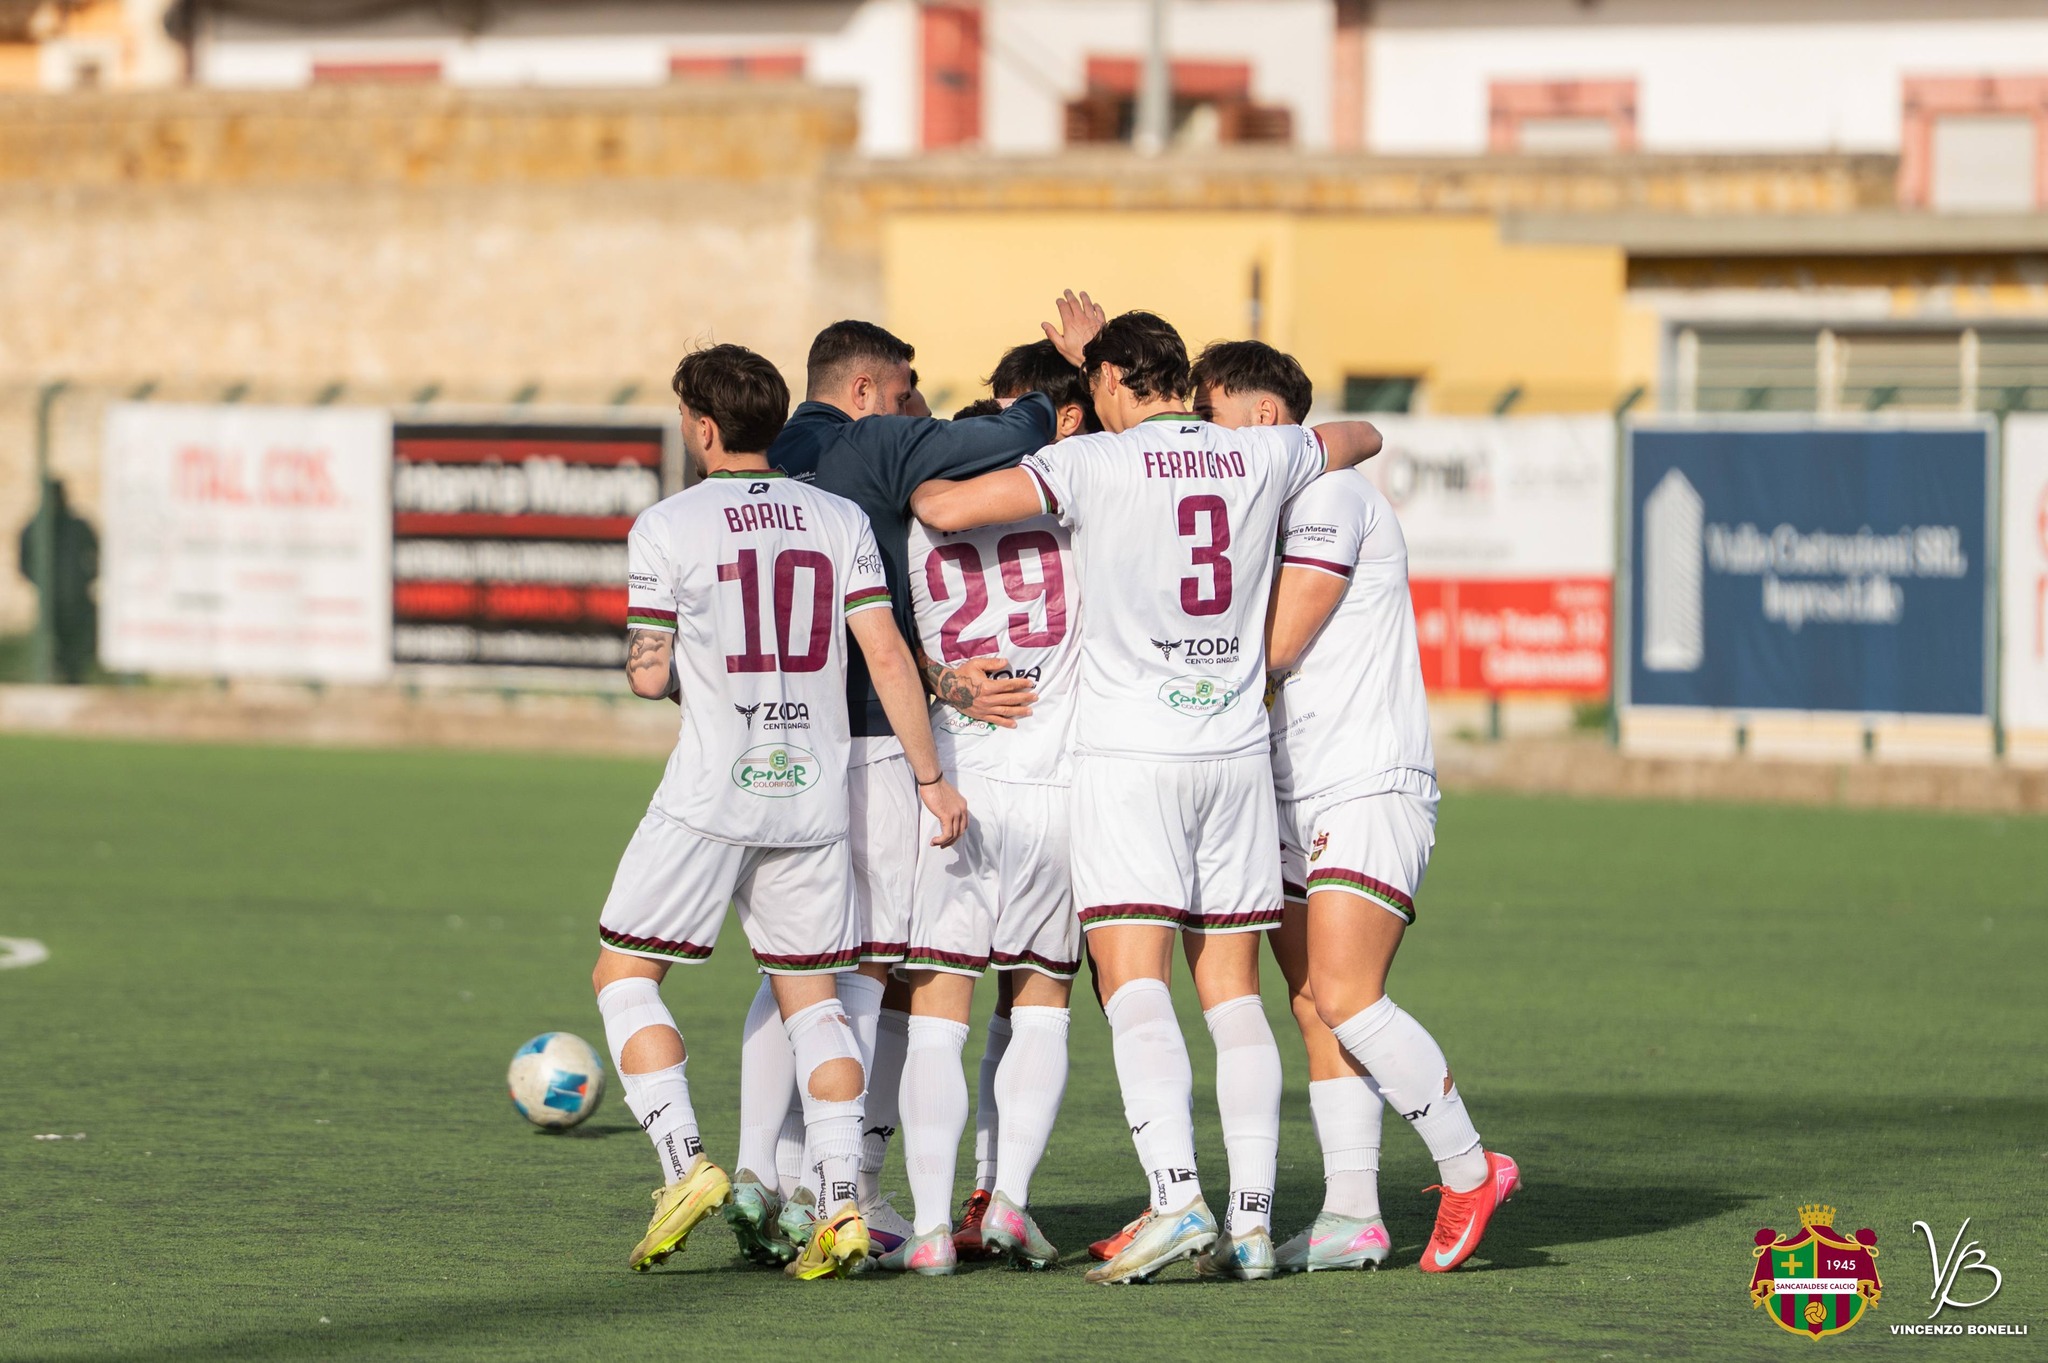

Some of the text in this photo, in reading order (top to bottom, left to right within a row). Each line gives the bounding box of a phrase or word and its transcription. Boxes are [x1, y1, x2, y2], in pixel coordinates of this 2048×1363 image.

[1143, 450, 1246, 479] FERRIGNO
[723, 502, 808, 533] BARILE
[1305, 525, 1337, 534] Materia
[1177, 494, 1233, 617] 3
[925, 529, 1068, 664] 29
[716, 549, 834, 674] 10
[1184, 636, 1239, 656] ZODA
[1185, 657, 1214, 665] CENTRO
[741, 764, 807, 788] SPIVER
[1241, 1192, 1270, 1213] FS
